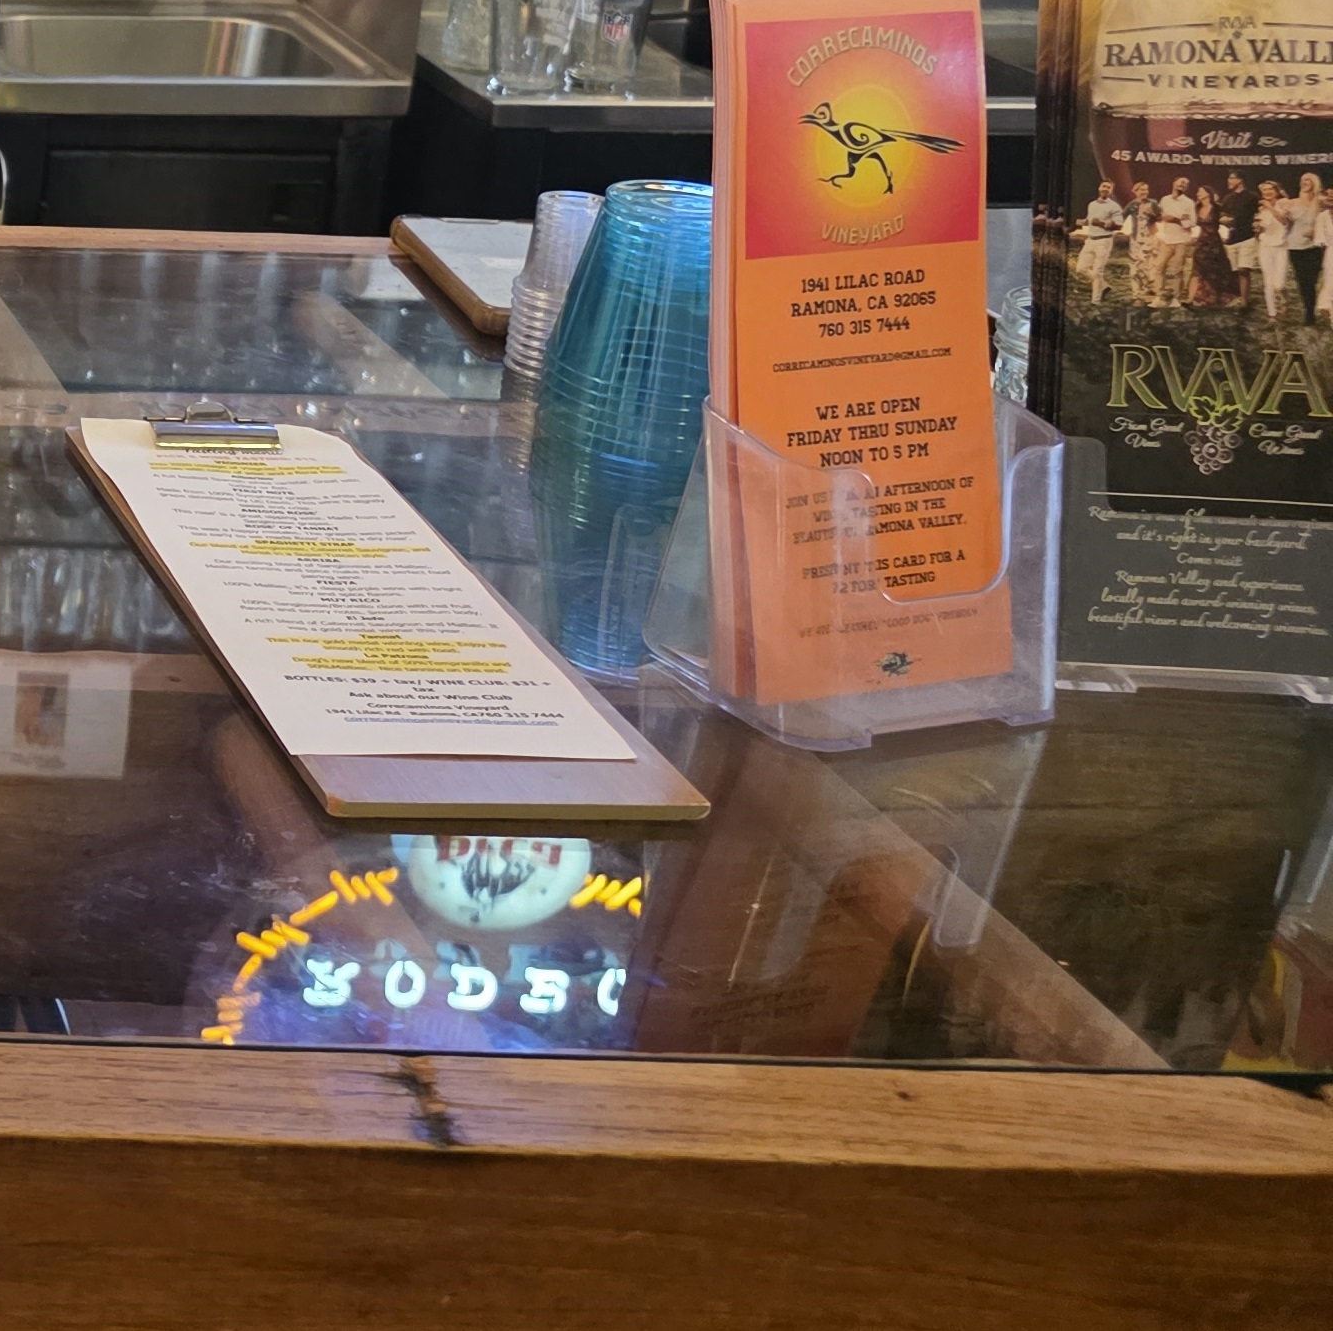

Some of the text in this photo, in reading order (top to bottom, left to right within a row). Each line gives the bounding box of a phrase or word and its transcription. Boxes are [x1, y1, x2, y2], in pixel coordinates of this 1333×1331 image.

[785, 25, 942, 88] CORRECAMINOS
[1102, 39, 1241, 67] RAMONA
[1148, 72, 1321, 88] VINEYARDS
[1201, 130, 1253, 149] Visit
[1111, 149, 1132, 162] 45
[1134, 151, 1272, 166] AWARD-WINNING
[821, 214, 905, 246] VINEYARD
[800, 269, 925, 294] 1941 LILAC ROAD
[790, 291, 937, 318] RAMONA, CA 92065
[818, 316, 910, 338] 760 315 7444
[816, 397, 921, 421] WE ARE OPEN
[787, 416, 958, 448] FRIDAY THRU SUNDAY
[820, 442, 930, 468] NOON TO 5 PM
[883, 476, 975, 497] AFTERNOON OF
[852, 497, 946, 518] TASTING IN THE
[893, 550, 966, 568] CARD FOR A
[884, 571, 936, 589] TASTING
